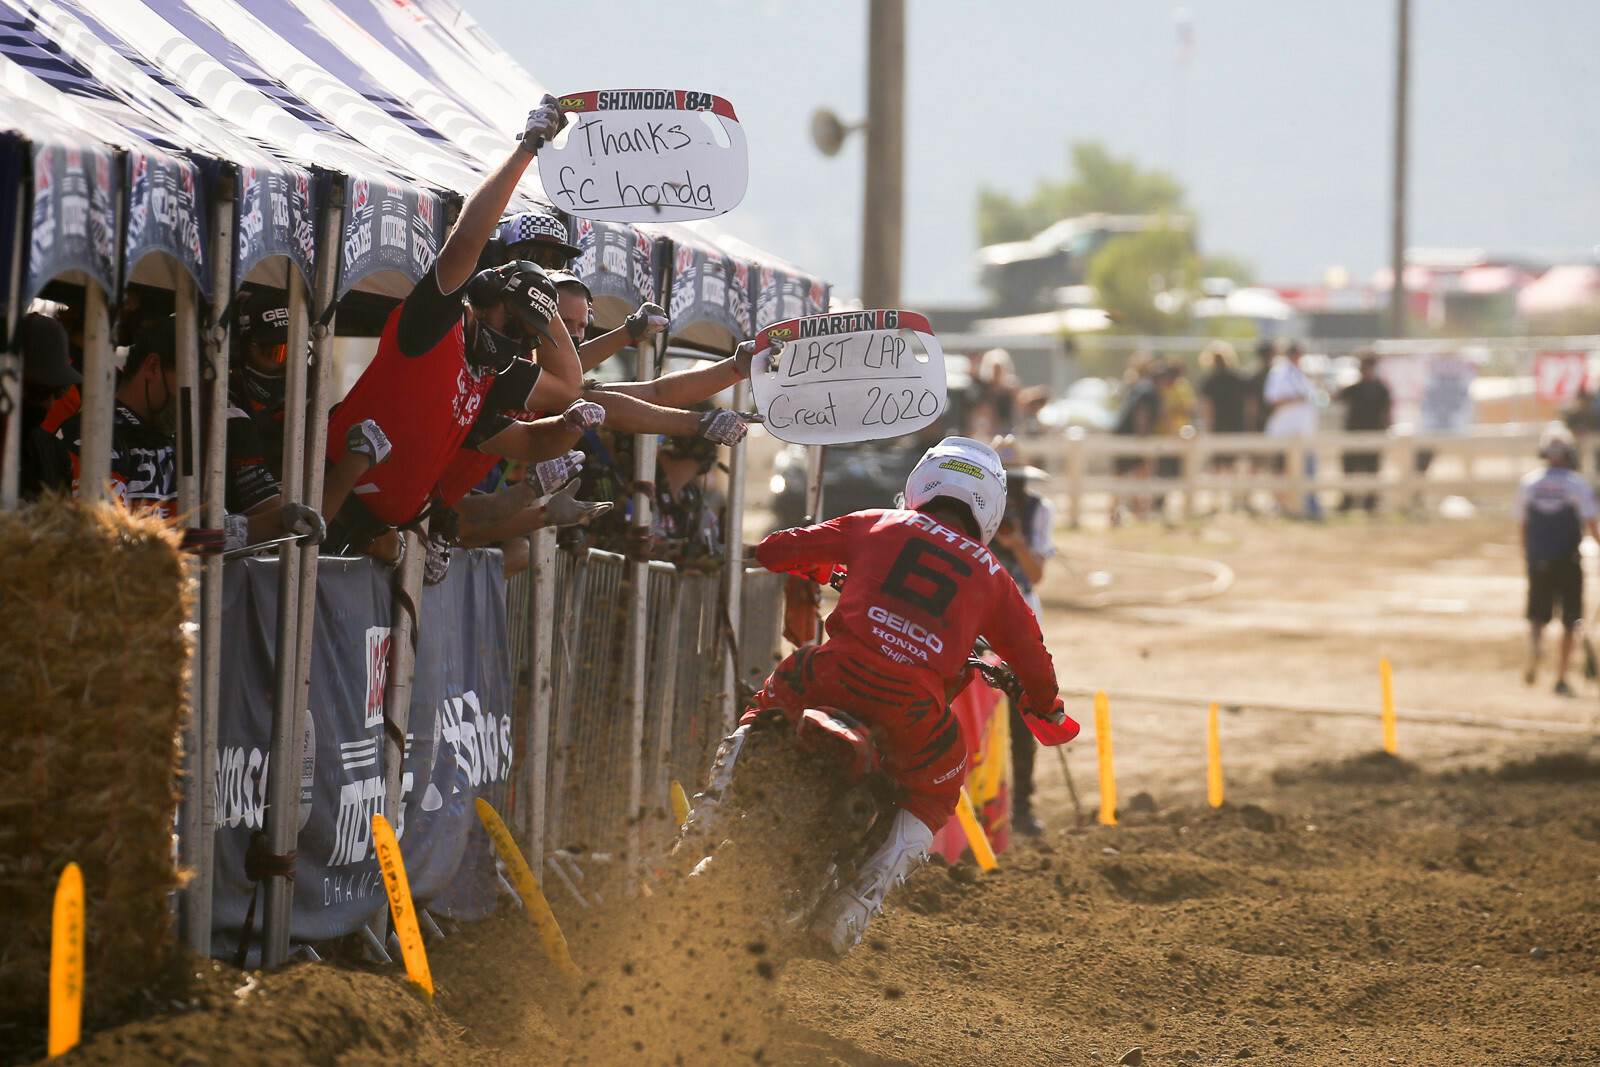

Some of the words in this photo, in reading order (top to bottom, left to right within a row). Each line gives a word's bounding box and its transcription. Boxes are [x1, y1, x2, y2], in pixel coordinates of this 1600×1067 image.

[597, 90, 677, 111] SHIMODA
[684, 90, 713, 111] 84
[578, 119, 691, 156] Thanks
[615, 169, 714, 206] honda
[529, 224, 566, 241] GEICO
[261, 307, 290, 322] GEI
[527, 286, 558, 317] GEIC
[799, 311, 878, 339] MARTIN
[884, 310, 899, 330] 6
[788, 337, 853, 378] LAST
[863, 333, 906, 370] LAP
[767, 393, 837, 429] Great
[861, 386, 939, 426] 2020
[874, 510, 1001, 576] MARTIN
[880, 536, 973, 618] 6
[867, 605, 944, 654] GEICO
[871, 626, 929, 661] HONDA
